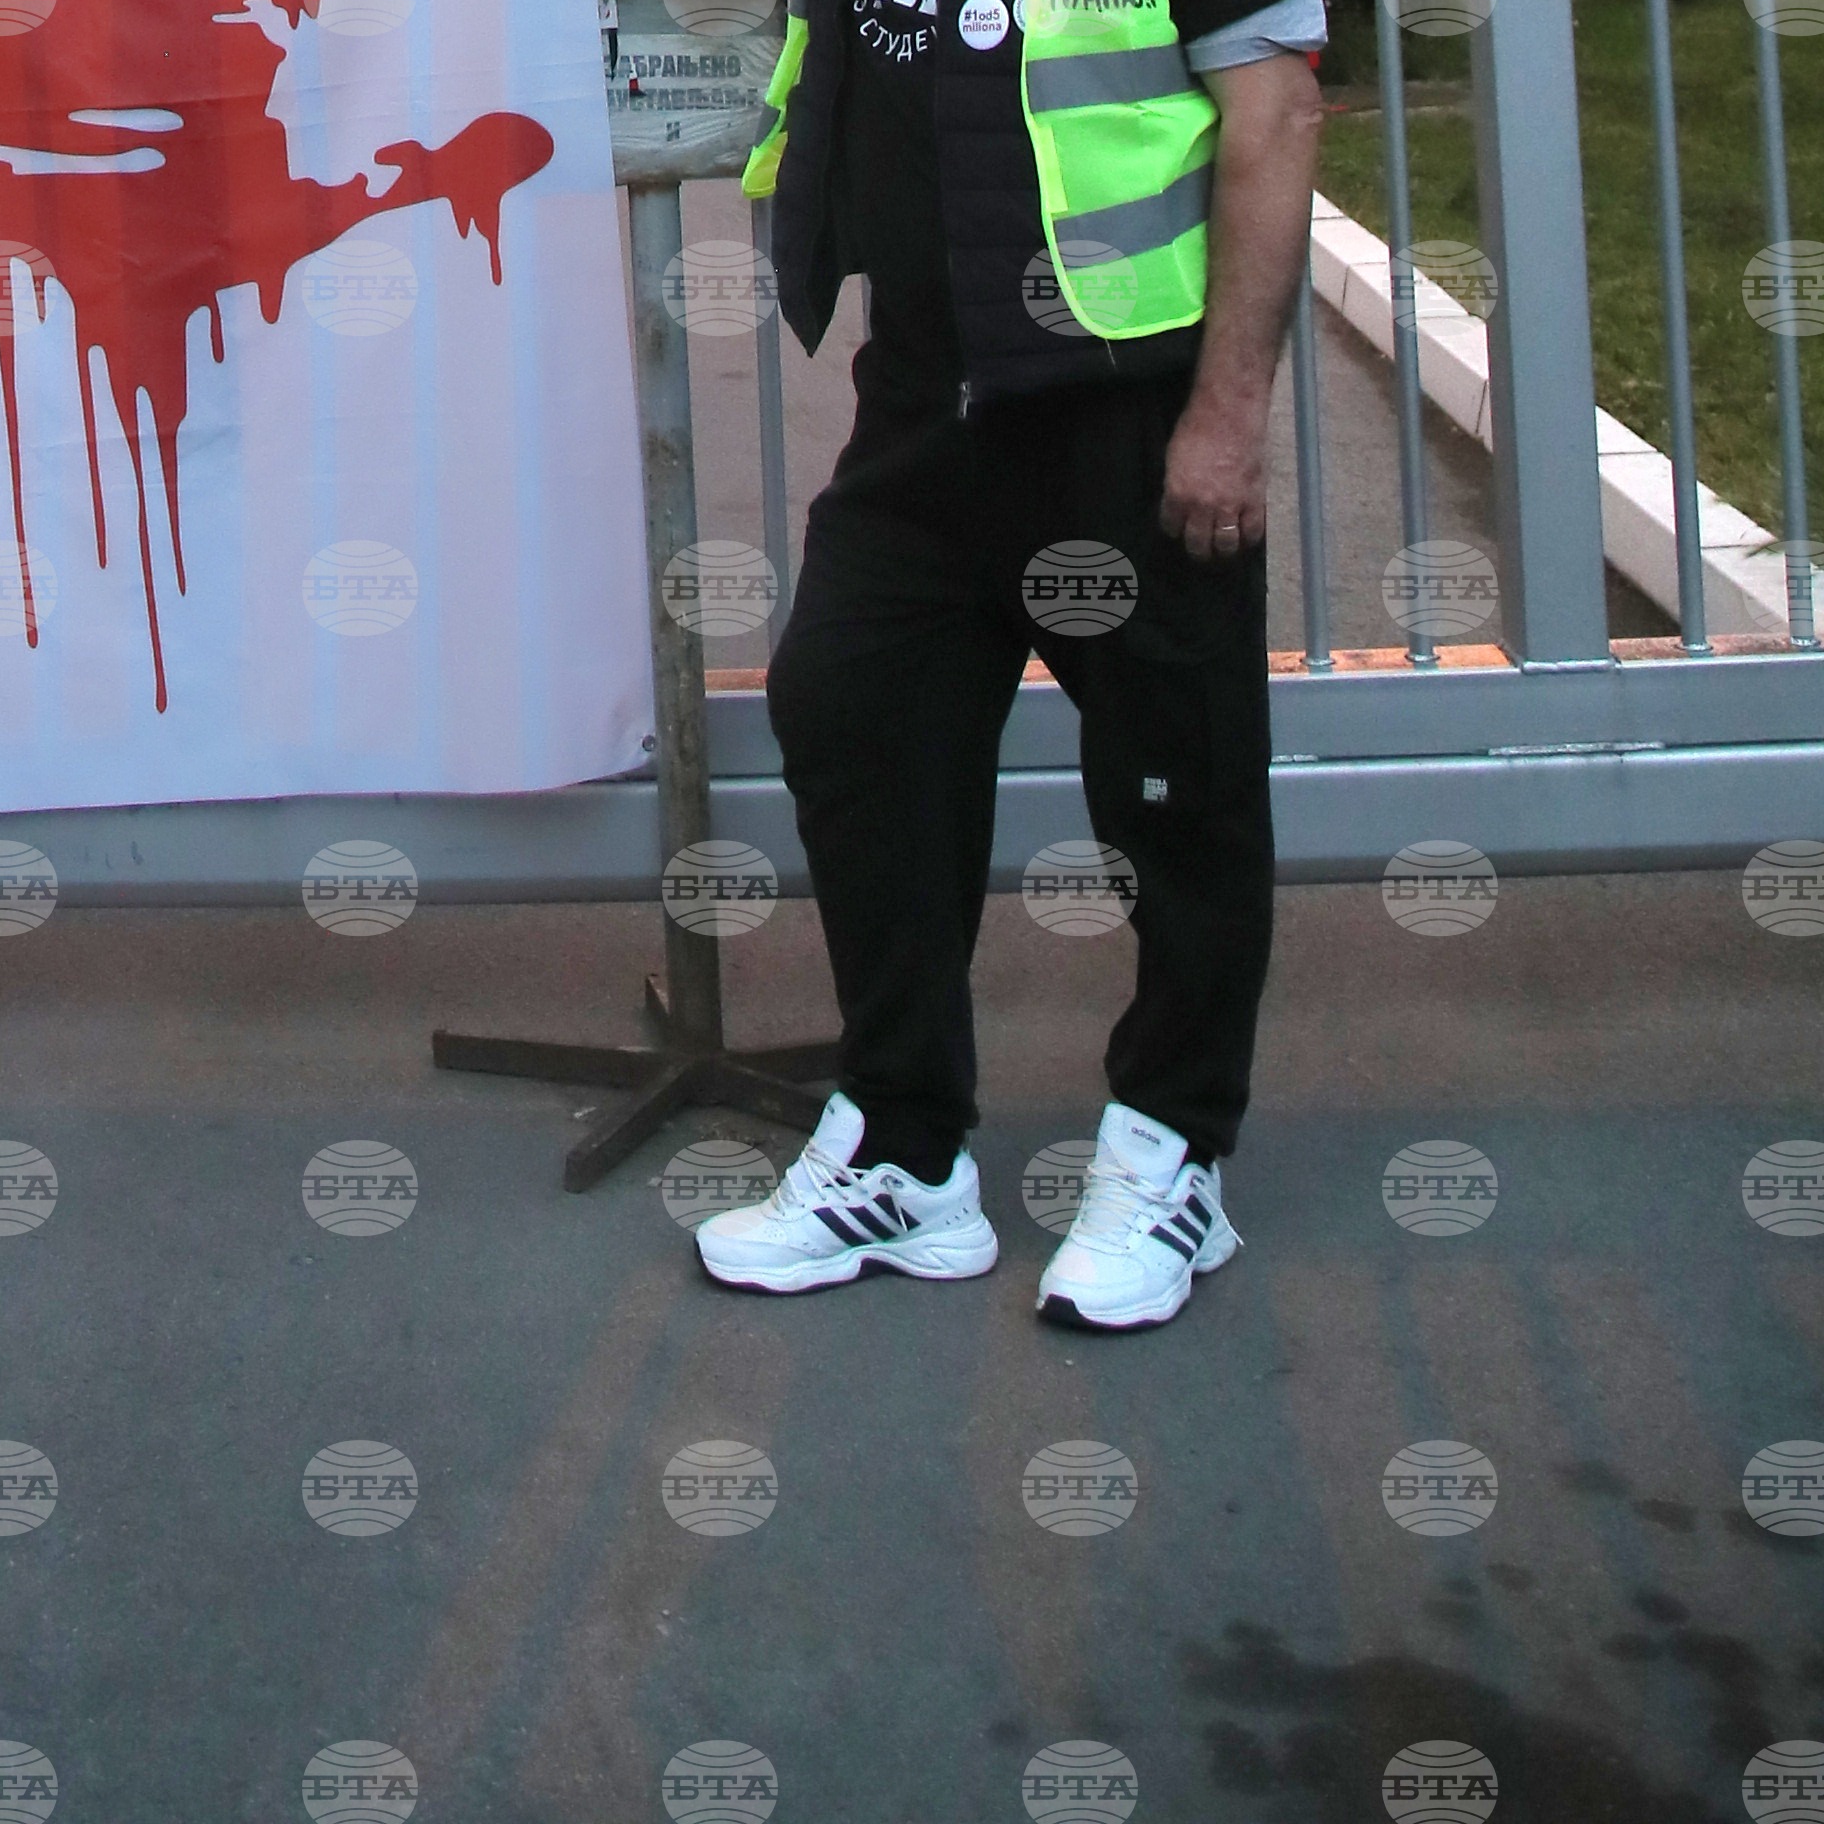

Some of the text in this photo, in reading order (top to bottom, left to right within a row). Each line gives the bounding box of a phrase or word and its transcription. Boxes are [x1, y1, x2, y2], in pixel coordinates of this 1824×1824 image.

[964, 9, 1001, 21] #1od5
[962, 22, 1002, 33] miliona
[859, 18, 938, 63] СТУДЕ
